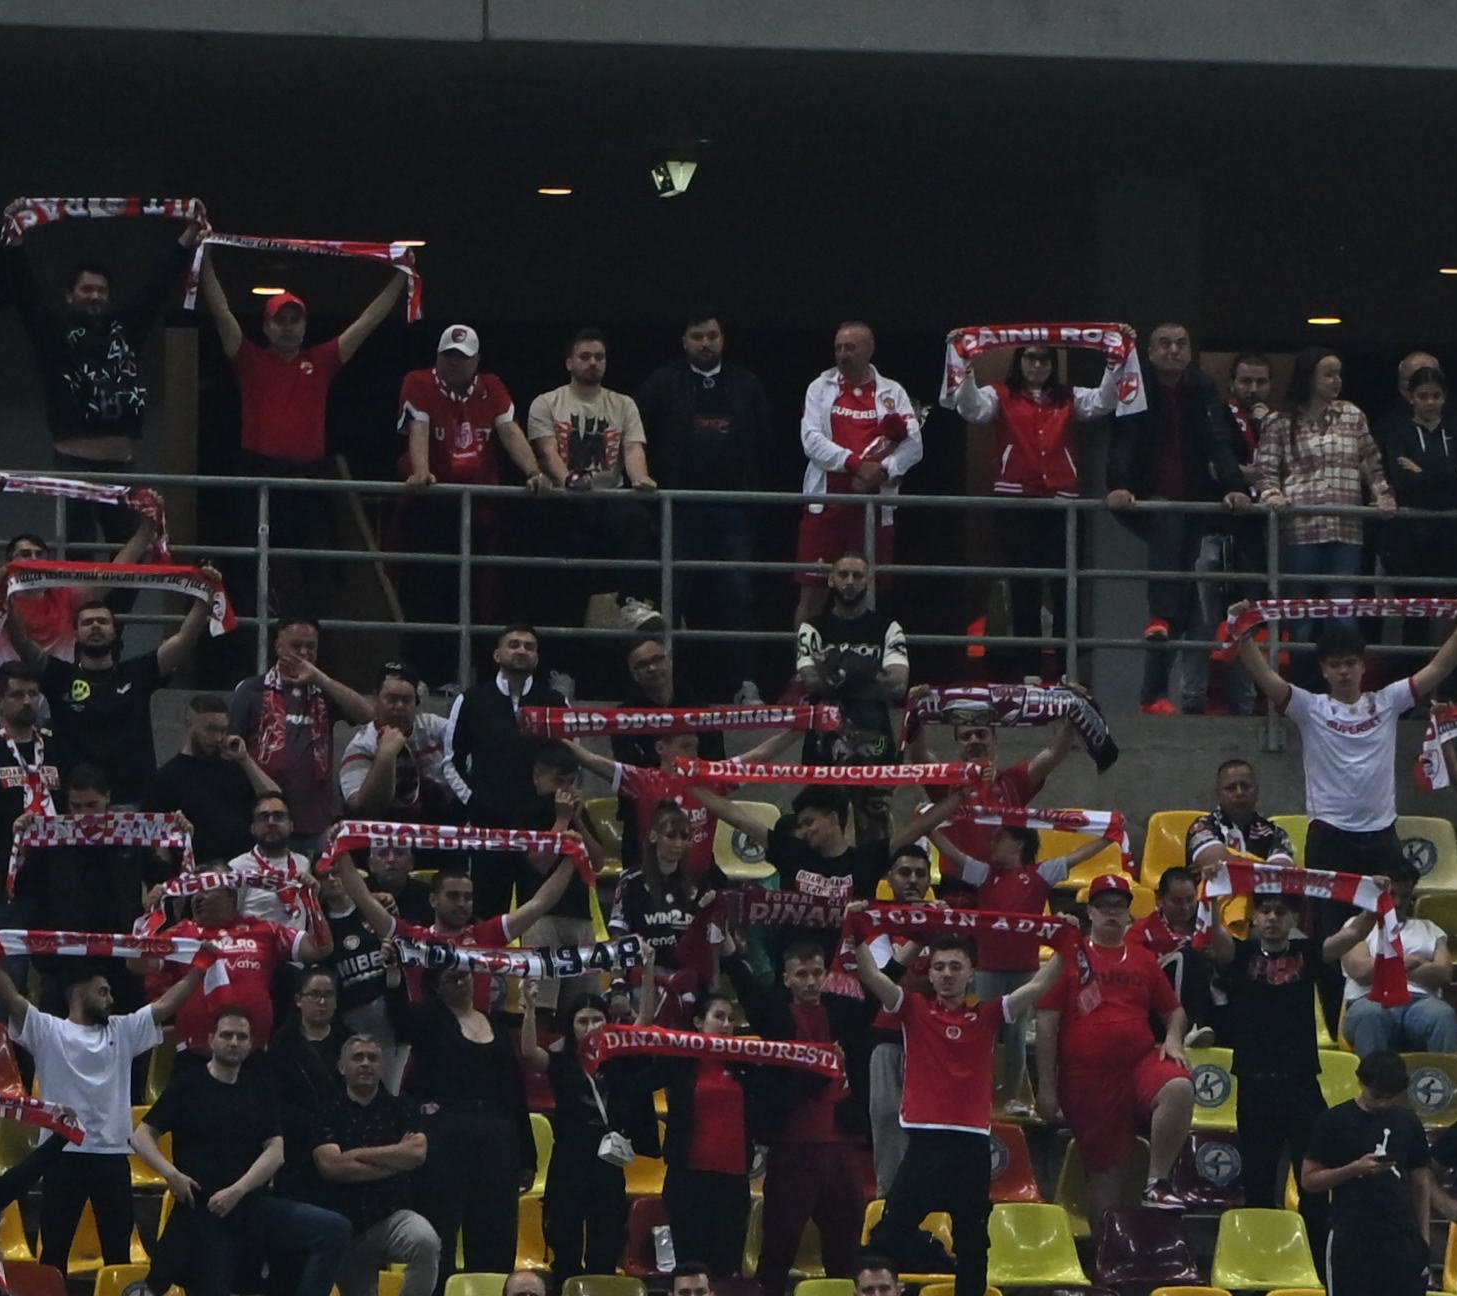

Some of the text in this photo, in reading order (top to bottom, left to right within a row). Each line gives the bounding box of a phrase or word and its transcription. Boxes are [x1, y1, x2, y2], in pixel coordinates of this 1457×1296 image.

[1260, 604, 1454, 621] BUCURESTI
[708, 761, 812, 782] DINAMO
[374, 836, 562, 857] BUCURESTI
[992, 914, 1063, 937] ADN
[537, 935, 642, 966] 1948
[605, 1030, 706, 1055] DINAMO
